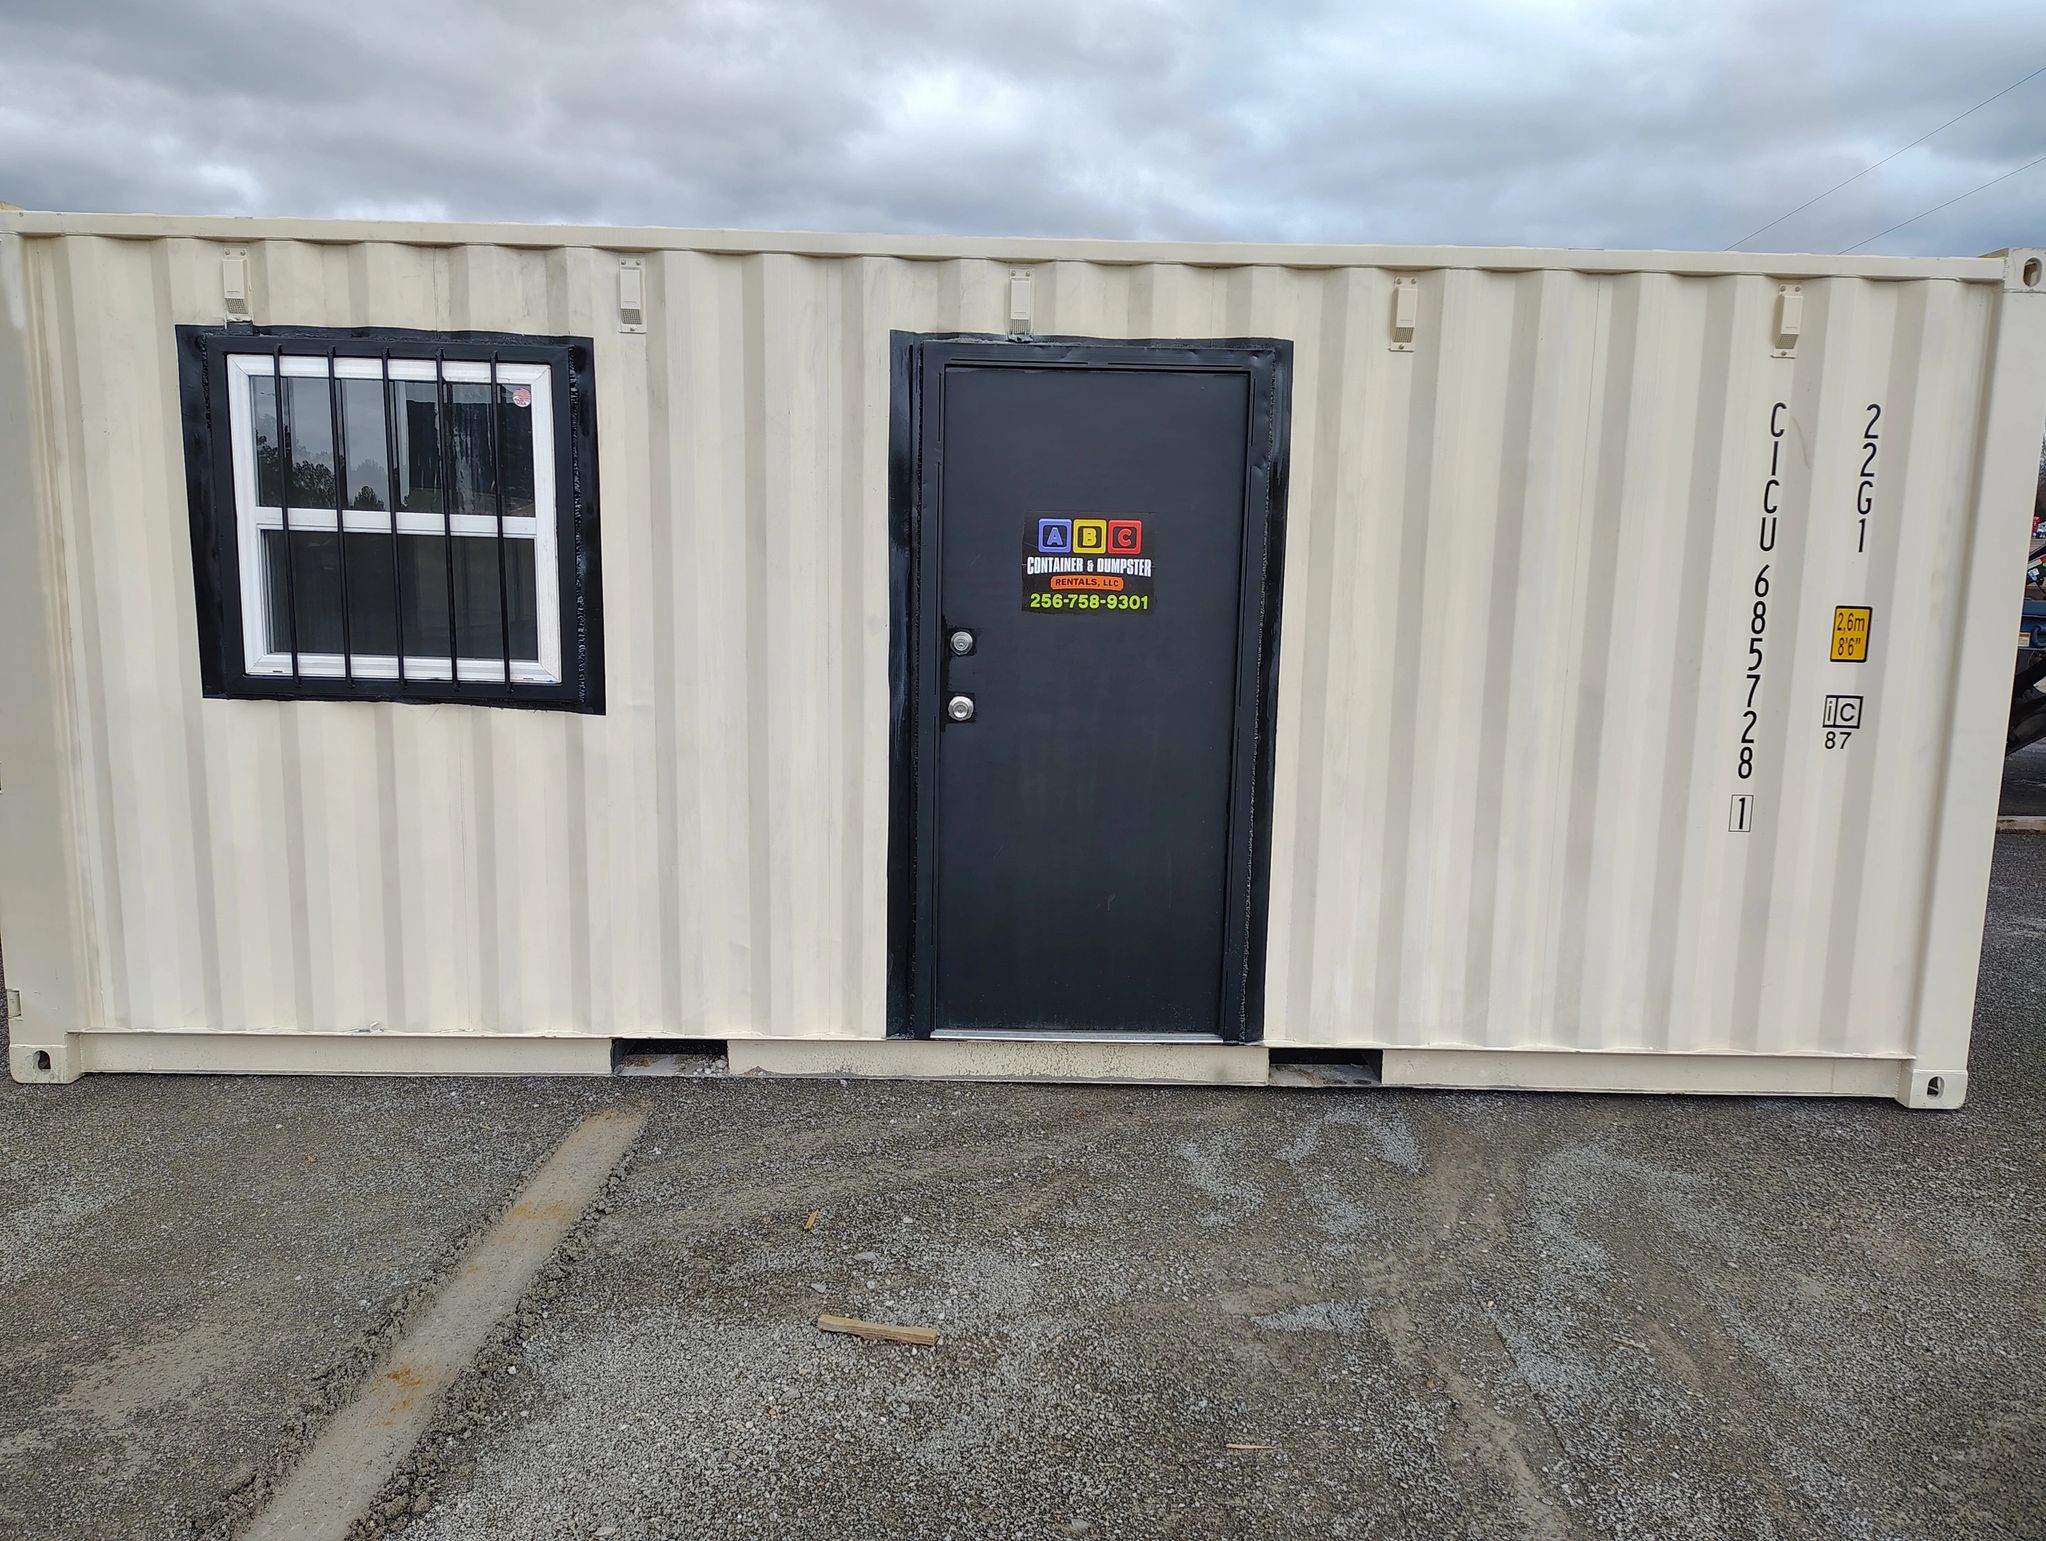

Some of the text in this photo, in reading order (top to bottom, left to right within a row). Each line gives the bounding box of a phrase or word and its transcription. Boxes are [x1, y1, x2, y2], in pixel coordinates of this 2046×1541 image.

[1760, 402, 1787, 551] CICU
[1857, 403, 1881, 552] 22G1
[1044, 525, 1134, 548] ABC
[1027, 556, 1152, 577] CONTAINER & DUMPSTER
[1055, 577, 1119, 587] RENTALS, LLC
[1030, 593, 1148, 610] 256-758-9301
[1738, 564, 1770, 779] 685728
[1824, 731, 1852, 750] 87
